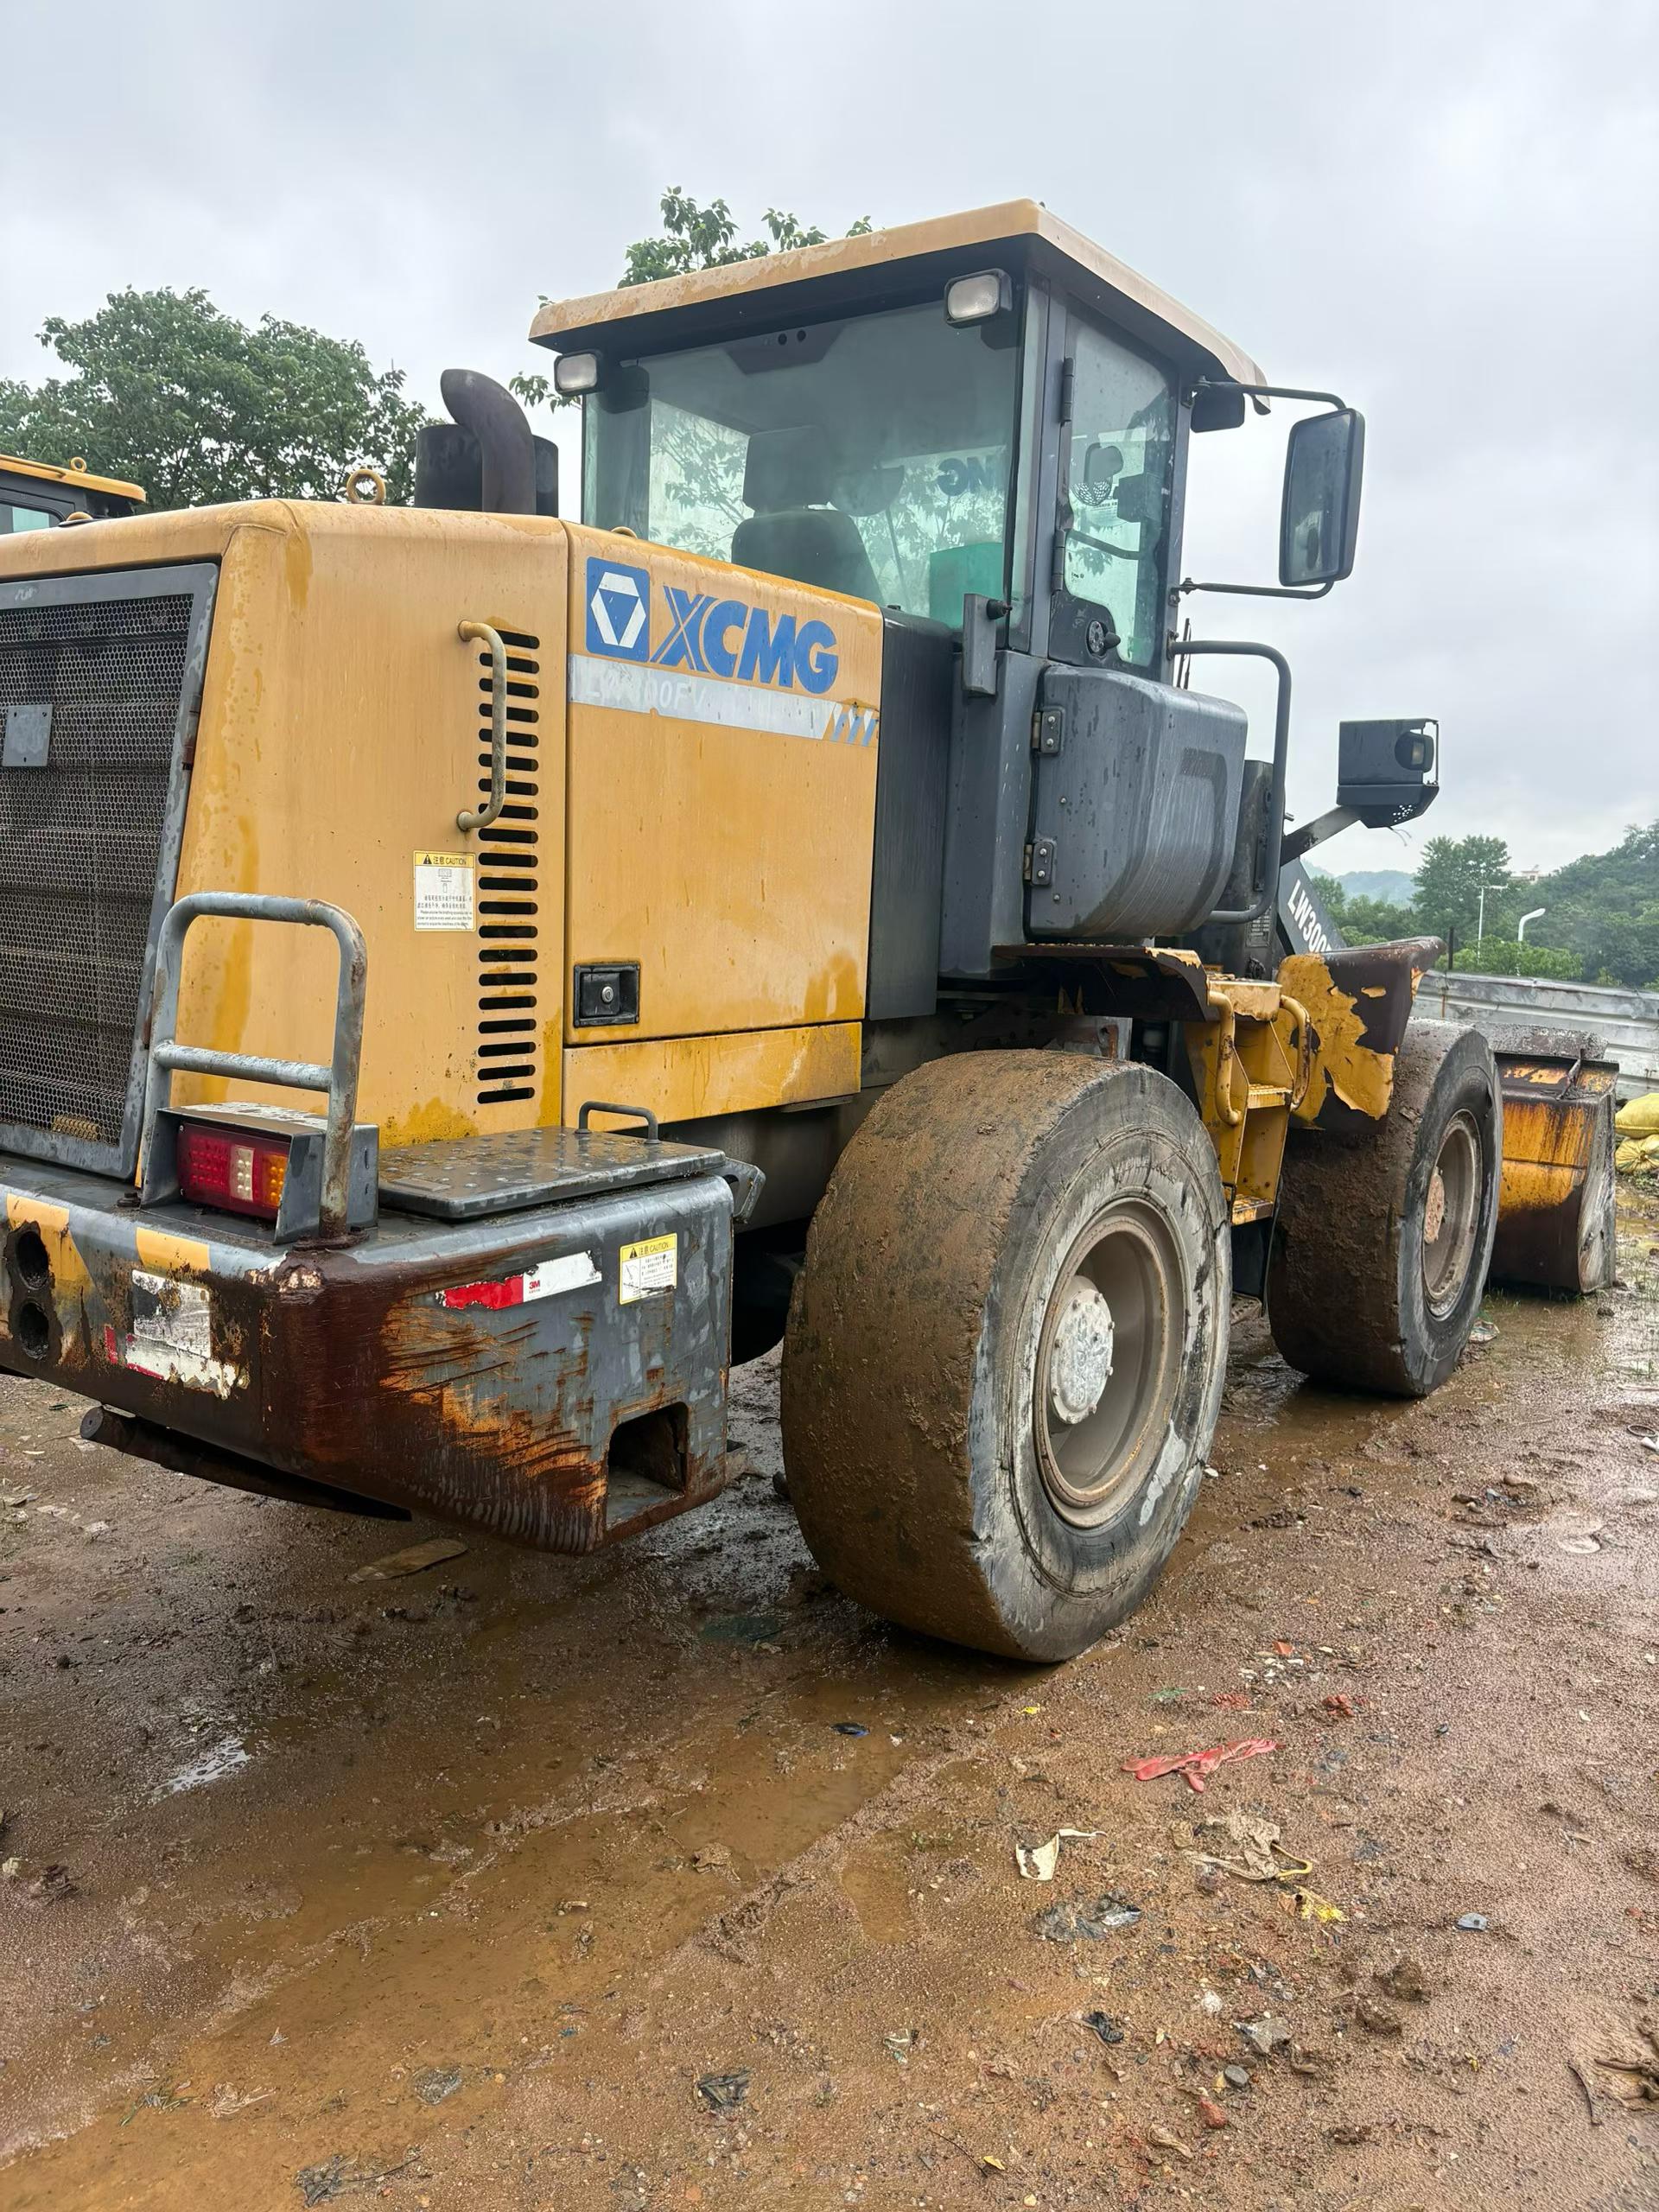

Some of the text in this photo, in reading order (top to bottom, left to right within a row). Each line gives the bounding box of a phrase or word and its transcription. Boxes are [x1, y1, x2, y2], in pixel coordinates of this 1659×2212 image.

[650, 585, 839, 694] XCMG
[1287, 879, 1332, 952] LW300
[529, 1280, 541, 1290] 3M
